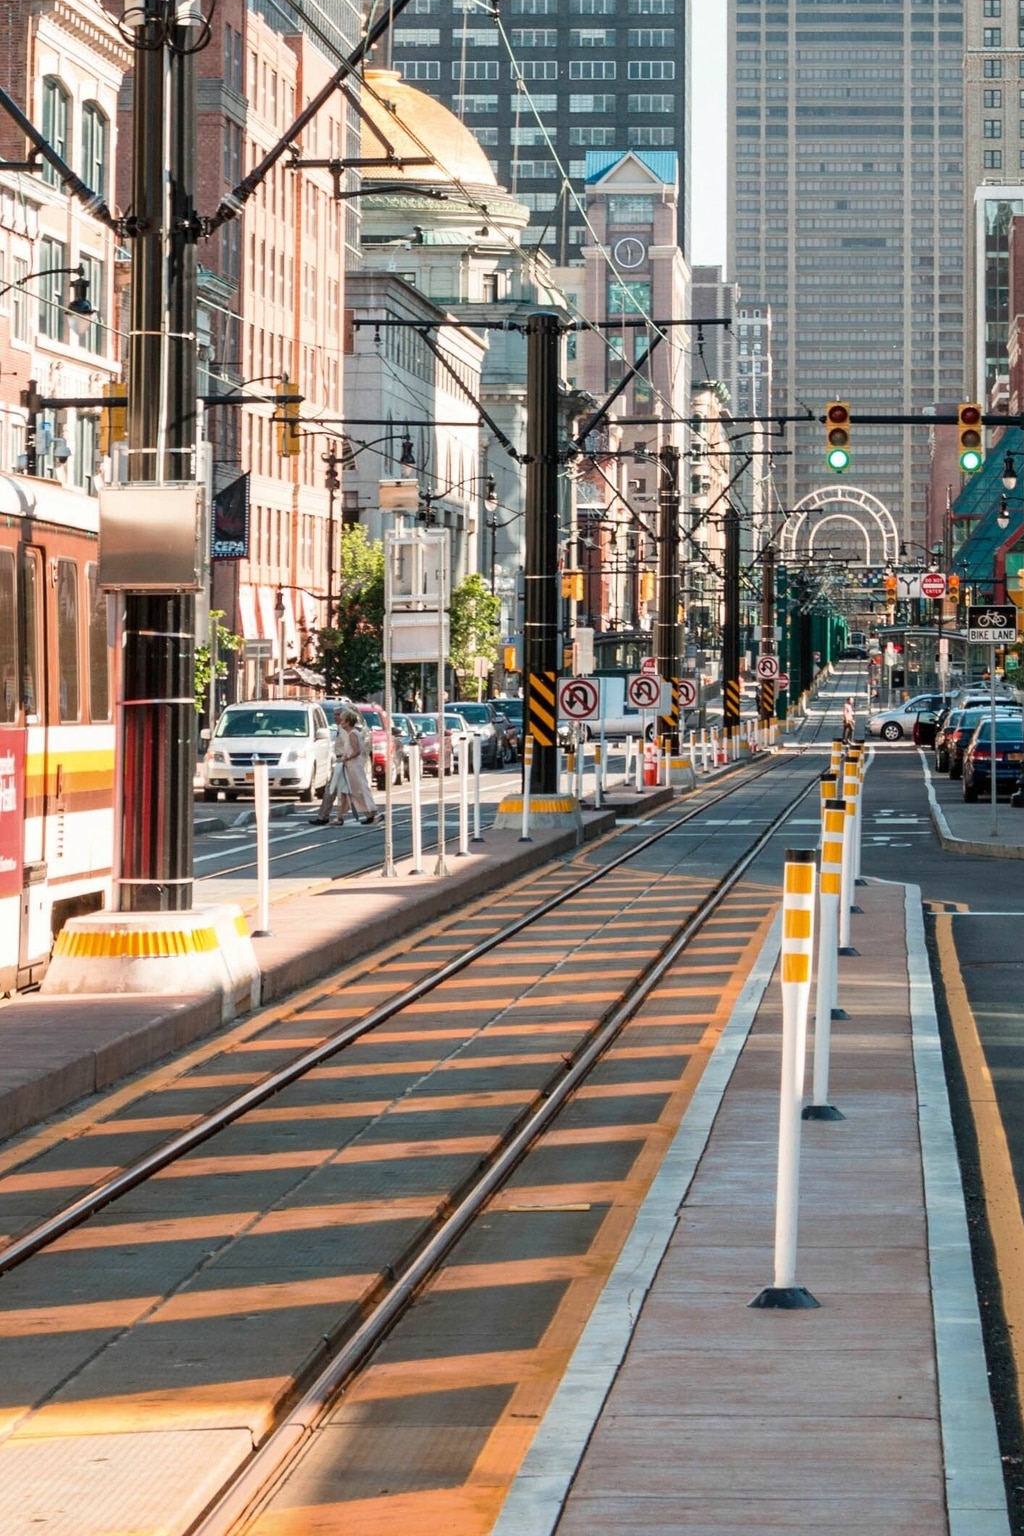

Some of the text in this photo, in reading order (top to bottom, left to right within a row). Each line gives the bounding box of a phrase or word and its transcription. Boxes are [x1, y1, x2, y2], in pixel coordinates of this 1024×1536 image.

[214, 541, 245, 552] CEPA
[971, 630, 1015, 640] BIKE LANE
